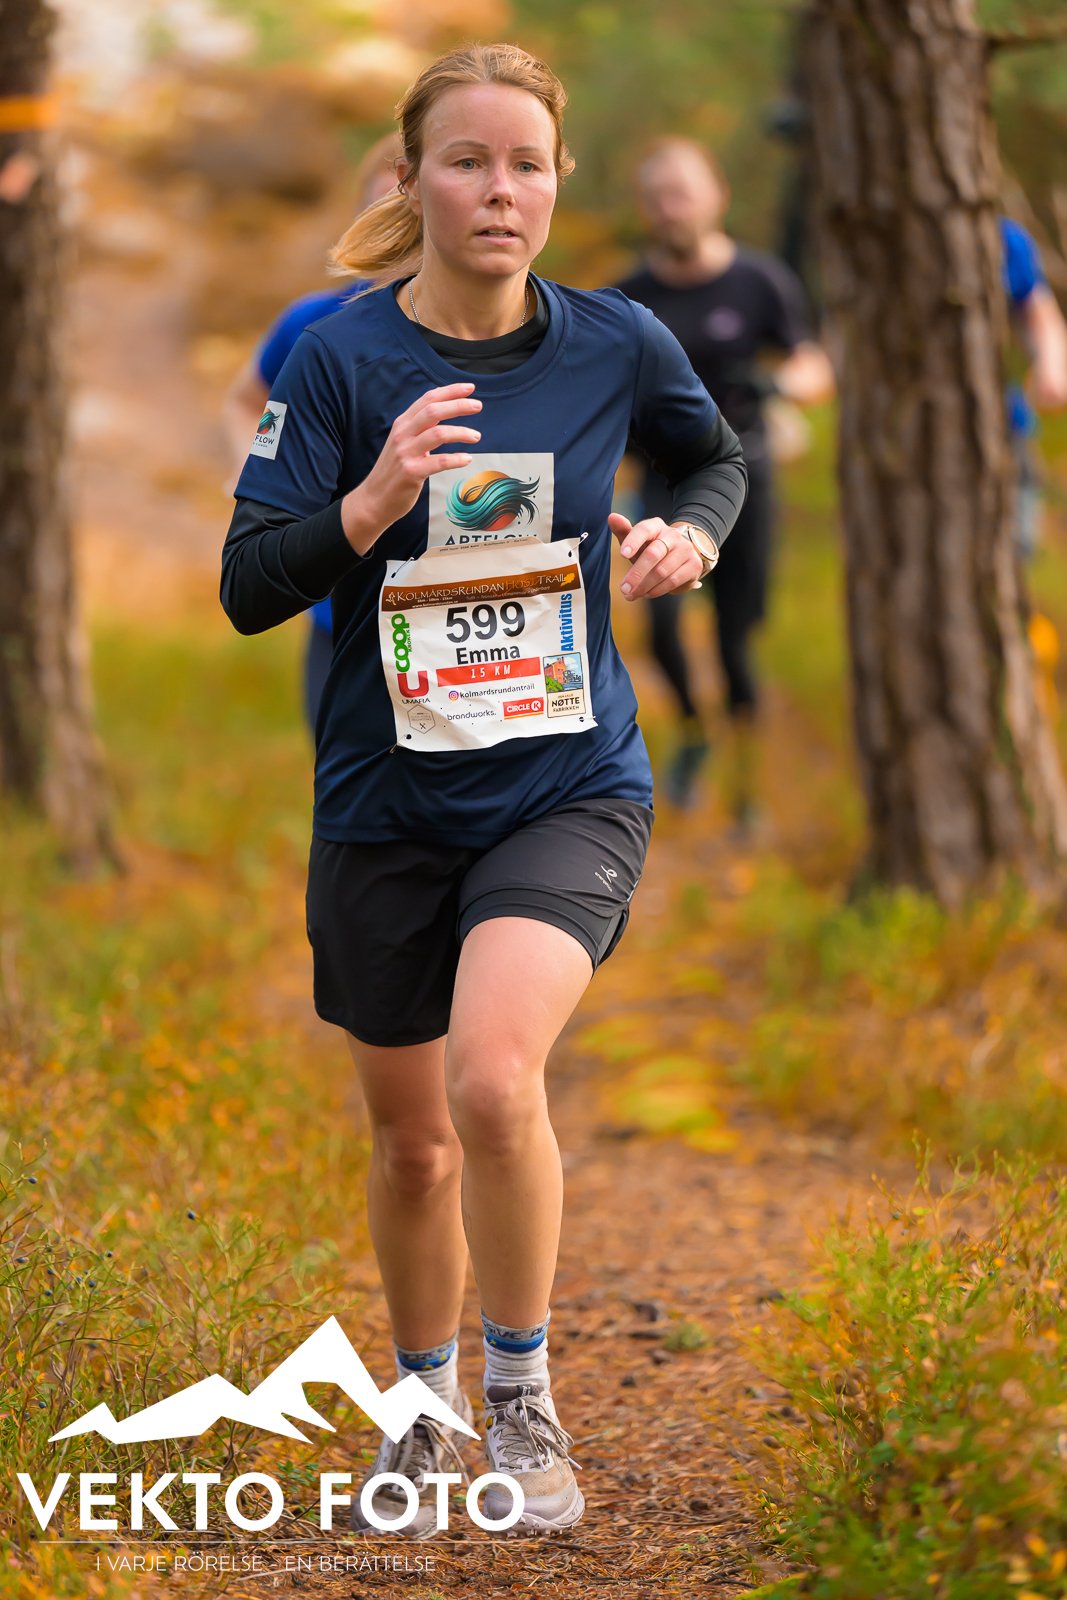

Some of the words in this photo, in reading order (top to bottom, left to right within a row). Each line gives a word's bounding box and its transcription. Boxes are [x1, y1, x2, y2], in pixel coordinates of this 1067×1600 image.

[537, 573, 566, 585] TRAIL
[446, 601, 526, 644] 599
[558, 593, 575, 652] Aktivitus
[391, 613, 411, 673] coop
[456, 645, 521, 666] Emma
[471, 667, 486, 679] 15
[494, 666, 512, 677] KM
[460, 683, 535, 699] kolmardsrundantrail
[506, 703, 531, 713] CIRCLE
[533, 702, 541, 711] K
[551, 697, 580, 708] NØTTE
